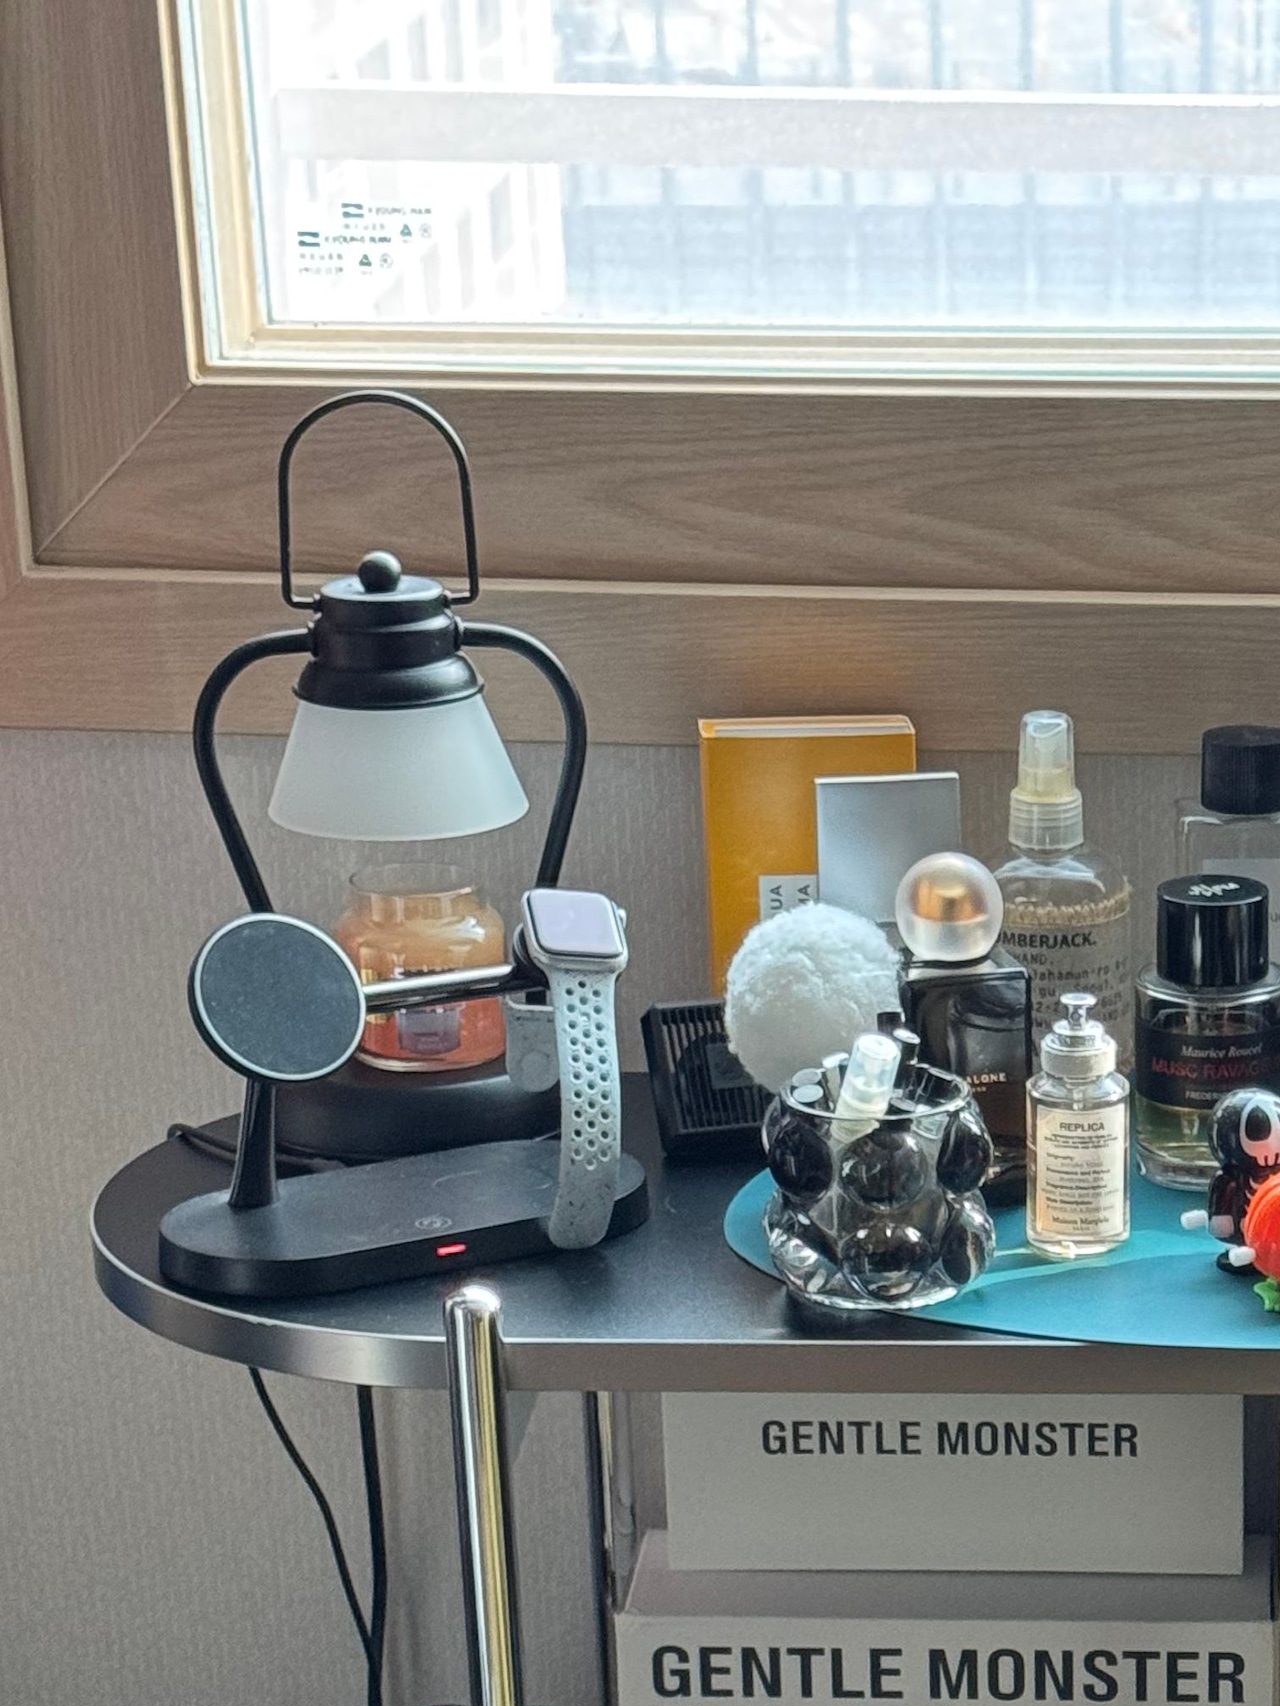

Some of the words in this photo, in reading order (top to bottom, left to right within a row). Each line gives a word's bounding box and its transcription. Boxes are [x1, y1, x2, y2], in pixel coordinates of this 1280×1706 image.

[1059, 1122, 1105, 1133] REPLICA
[761, 1420, 922, 1456] GENTLE
[937, 1421, 1139, 1457] MONSTER
[651, 1645, 905, 1698] GENTLE
[927, 1648, 1246, 1704] MONSTER
